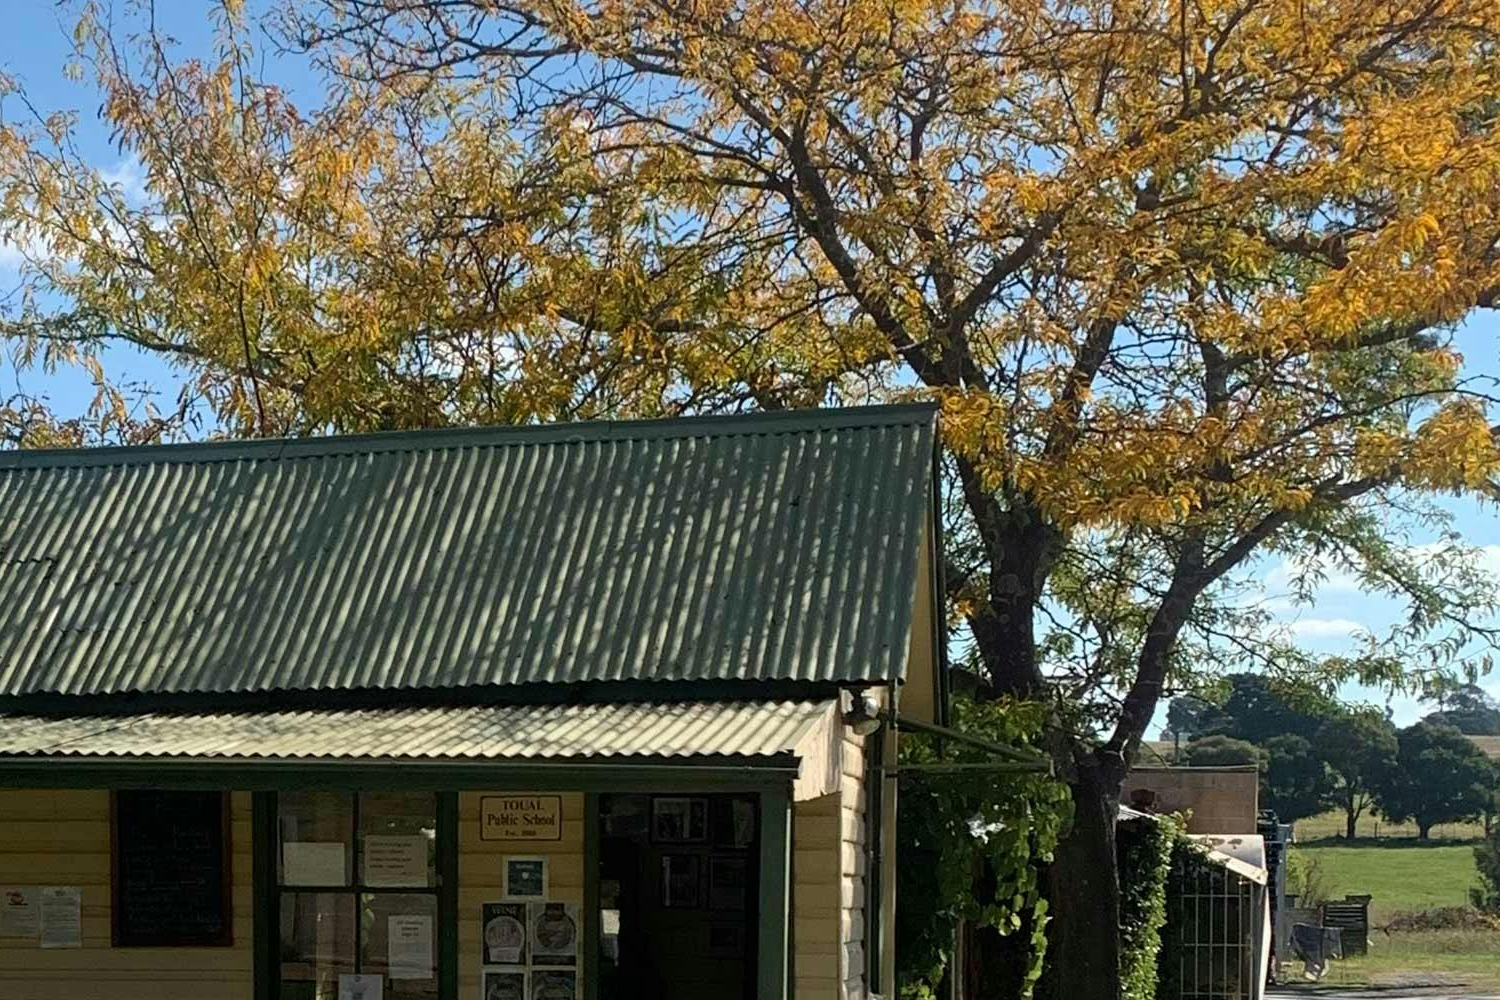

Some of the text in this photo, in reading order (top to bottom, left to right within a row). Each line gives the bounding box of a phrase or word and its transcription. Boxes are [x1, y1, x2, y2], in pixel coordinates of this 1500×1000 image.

[502, 800, 544, 810] TOUAL
[487, 813, 555, 826] Public School
